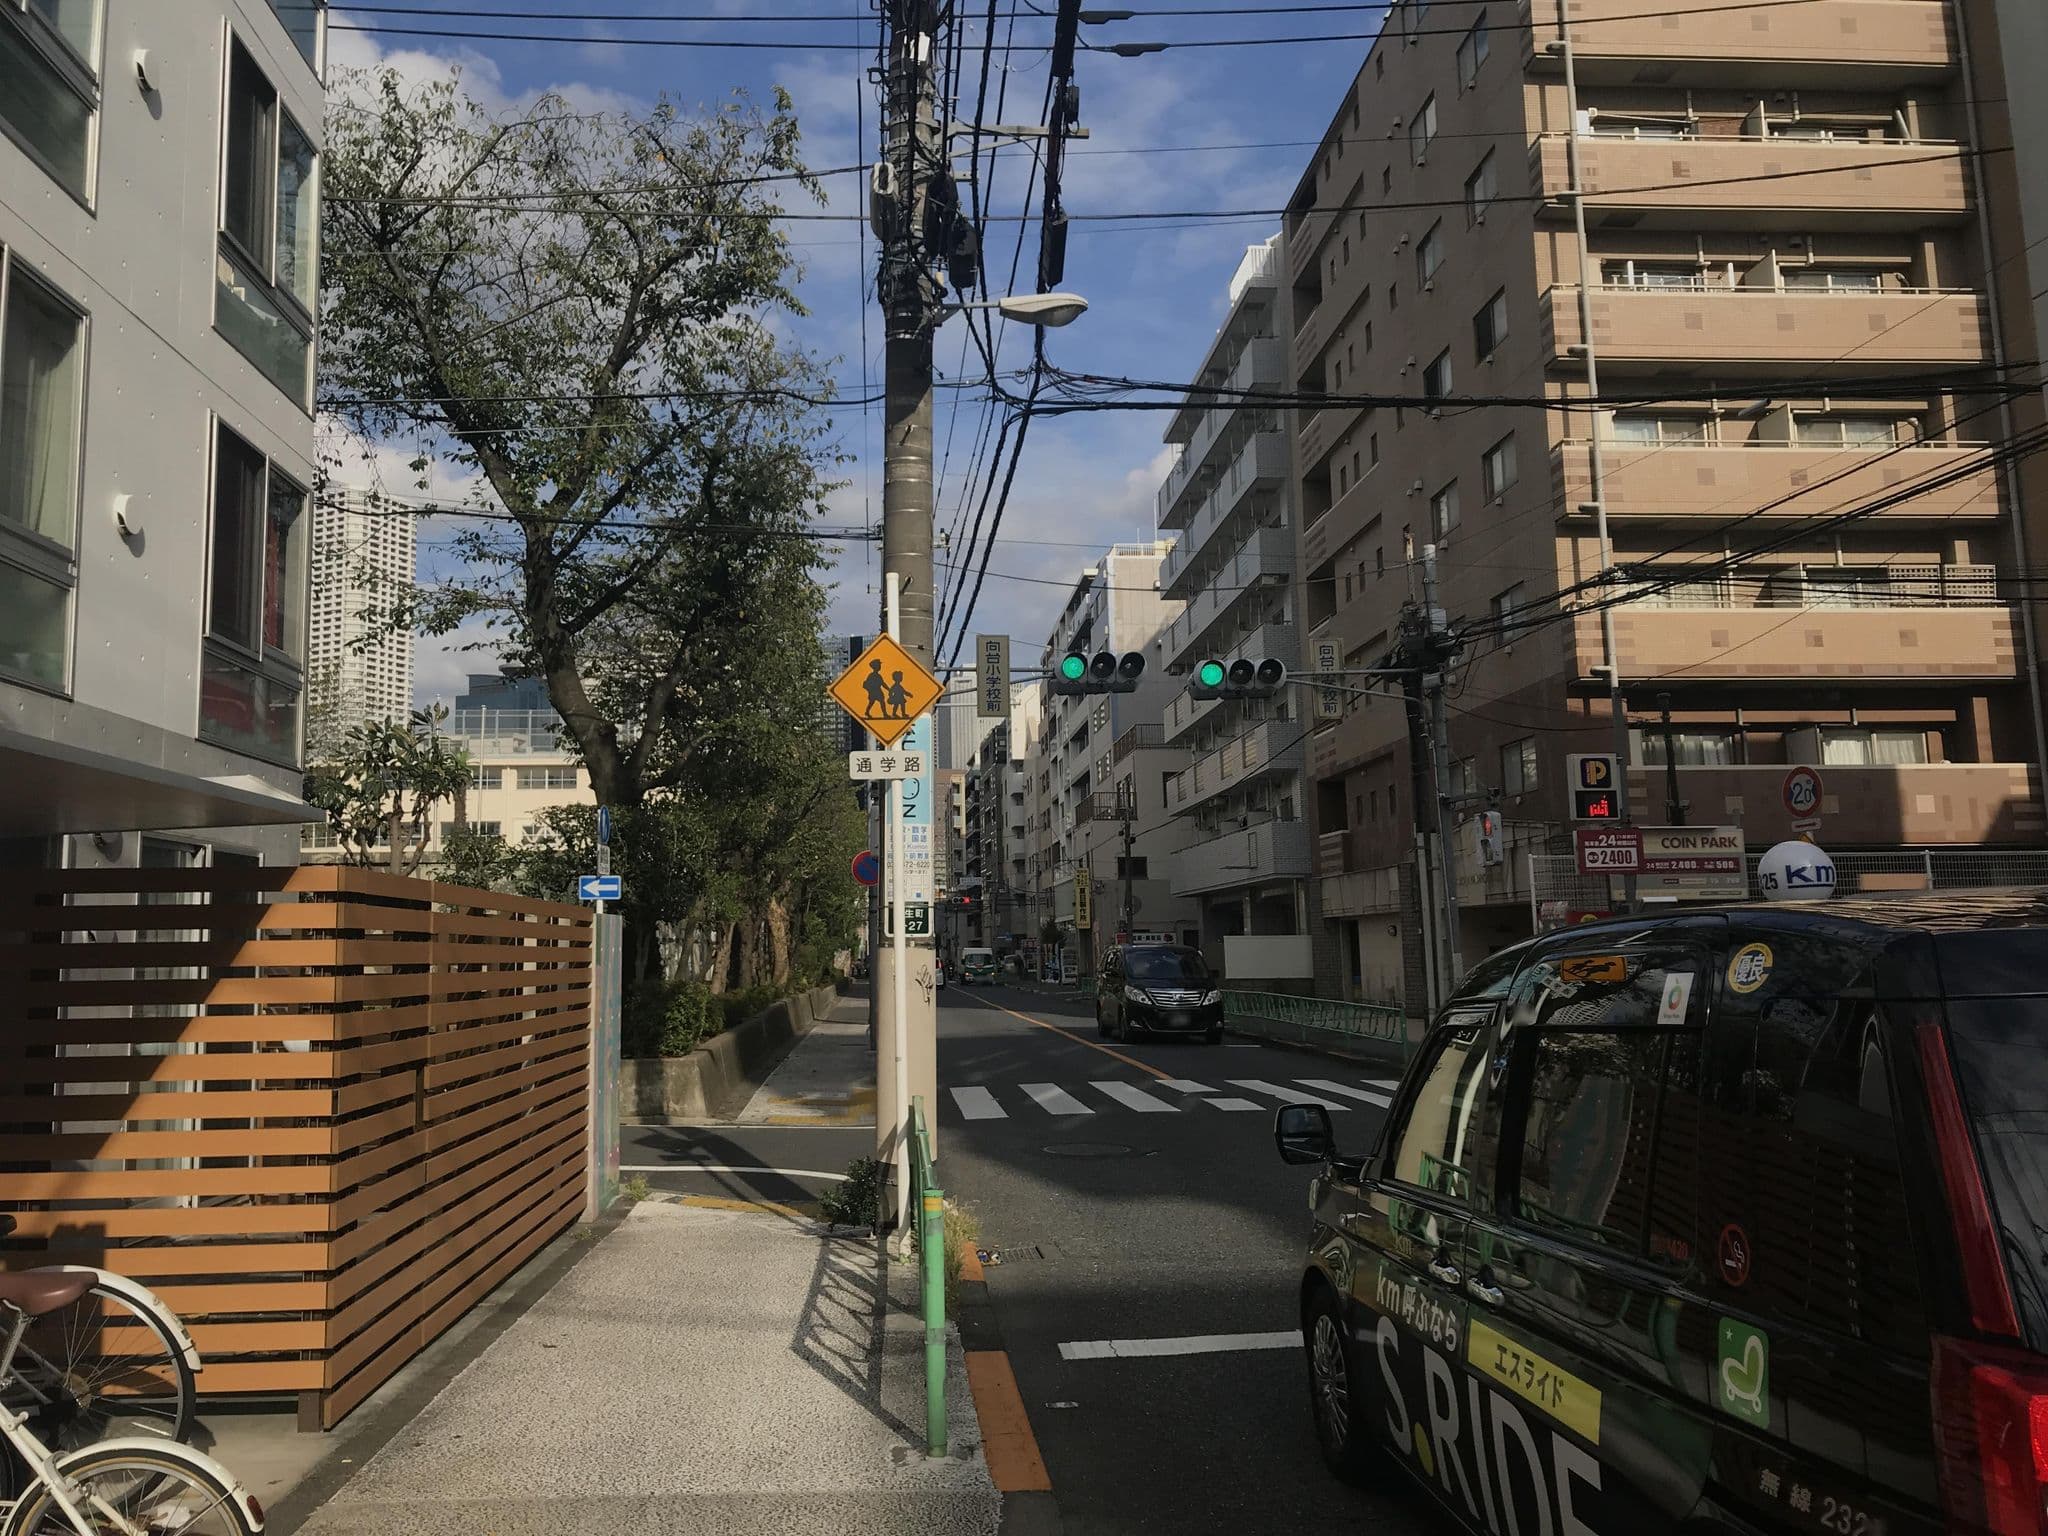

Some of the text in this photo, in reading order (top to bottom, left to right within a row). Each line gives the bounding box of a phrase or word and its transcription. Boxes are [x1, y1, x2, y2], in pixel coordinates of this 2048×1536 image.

[985, 640, 1002, 711] 向台小学校前
[856, 757, 921, 773] 通学路
[1661, 836, 1739, 849] COIN PARK
[904, 908, 924, 918] 生町
[1493, 1343, 1565, 1408] エスライド
[1376, 1314, 1603, 1536] S.RIDE
